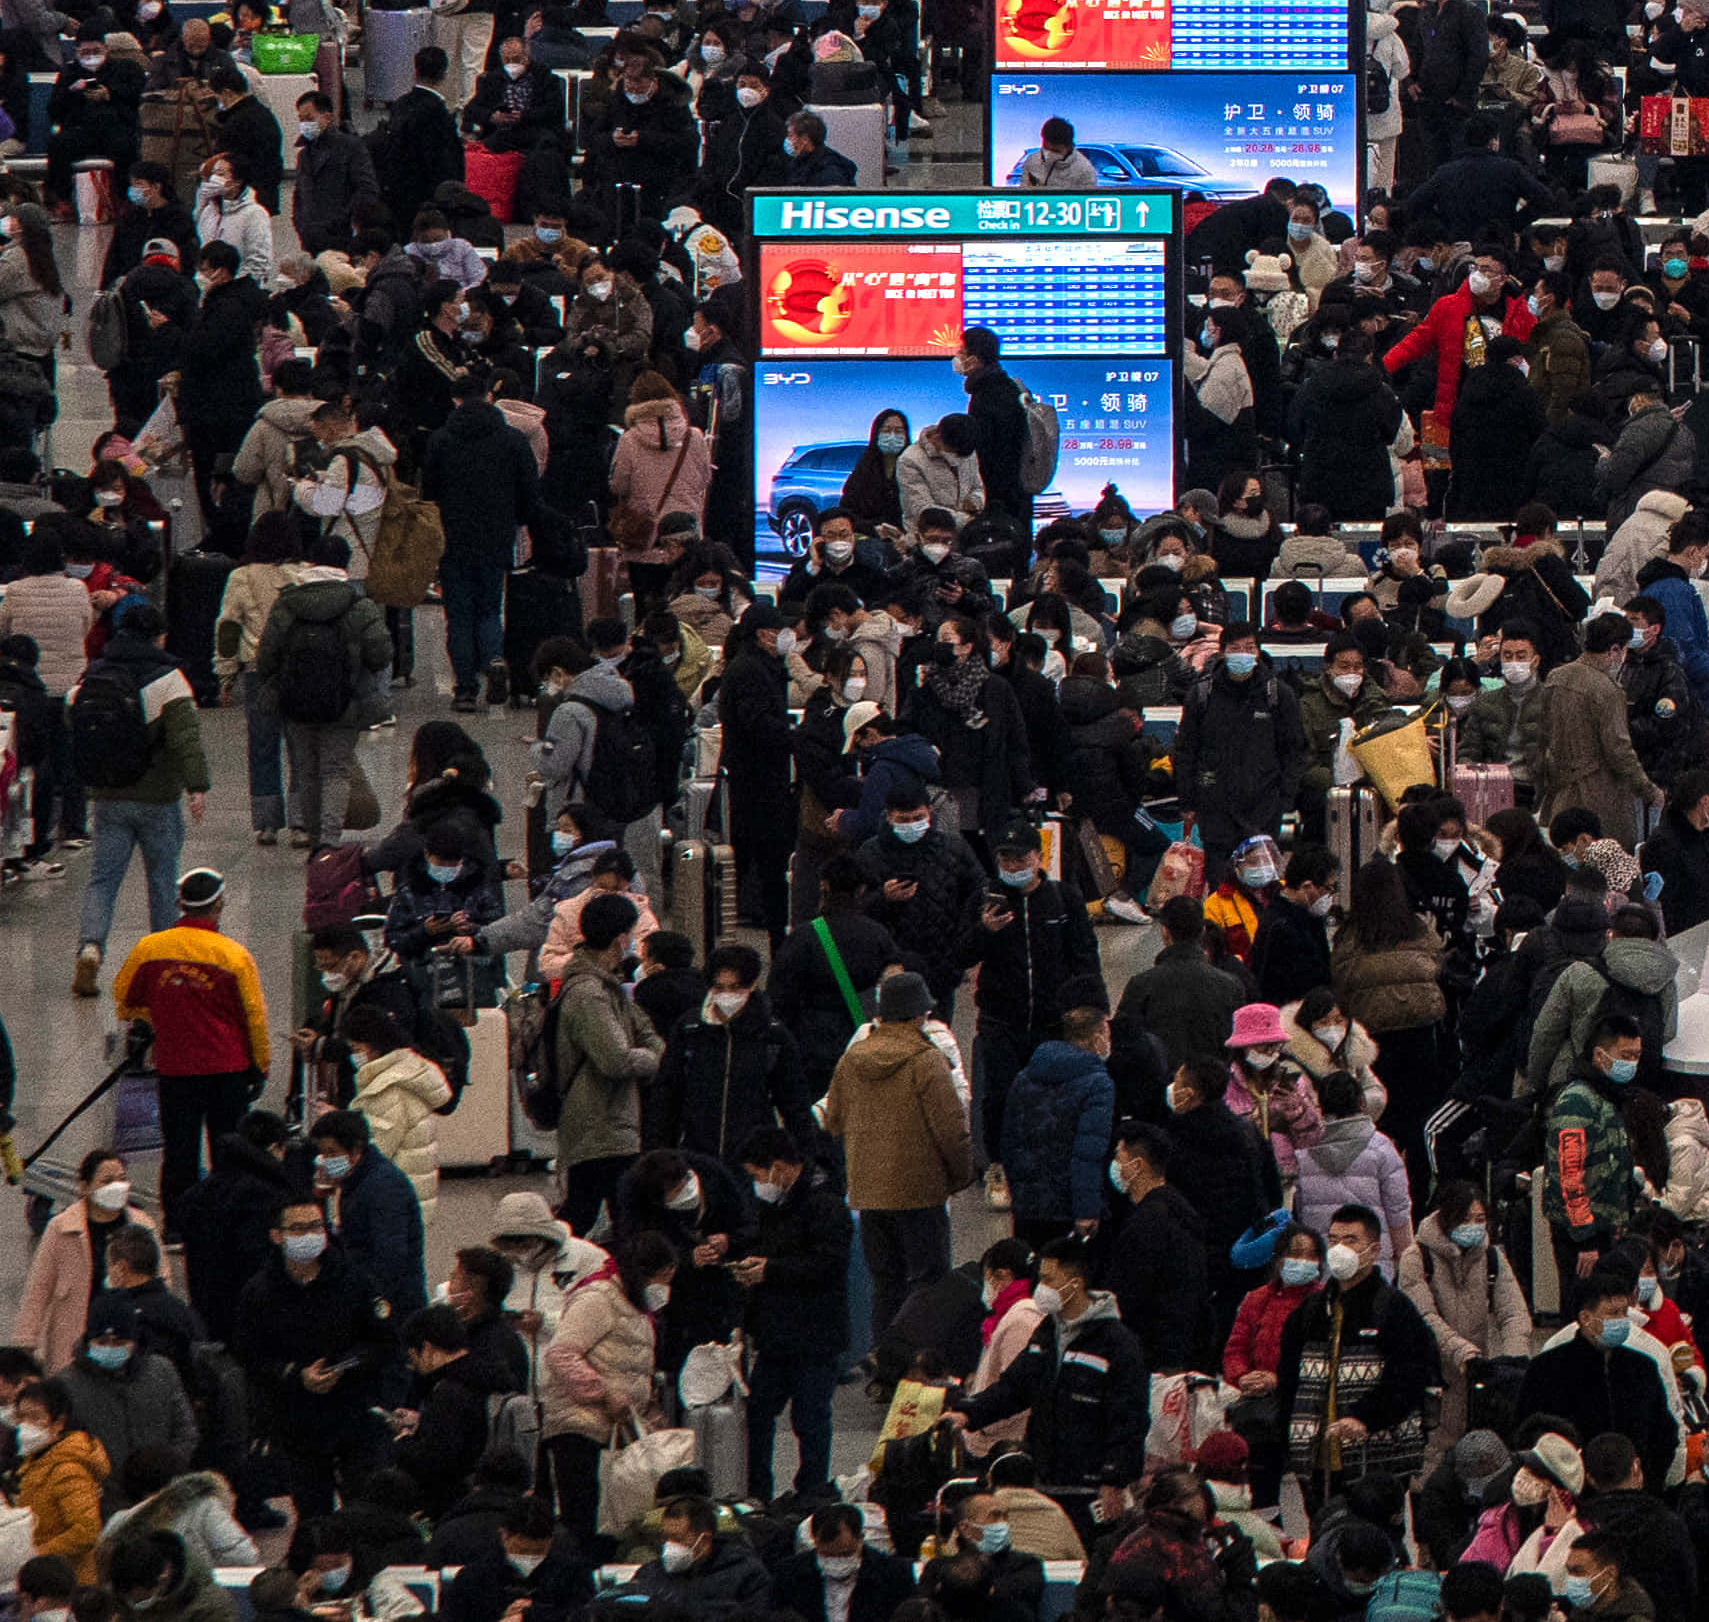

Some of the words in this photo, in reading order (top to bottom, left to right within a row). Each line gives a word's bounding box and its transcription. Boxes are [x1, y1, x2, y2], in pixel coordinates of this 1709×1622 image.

[1224, 103, 1335, 121] 护卫·领骑
[781, 201, 951, 230] Hisense
[976, 200, 1021, 219] 检票口
[1025, 202, 1082, 226] 12-30
[978, 220, 1007, 230] Check
[1009, 220, 1021, 230] in
[1032, 393, 1148, 413] 卫·领骑
